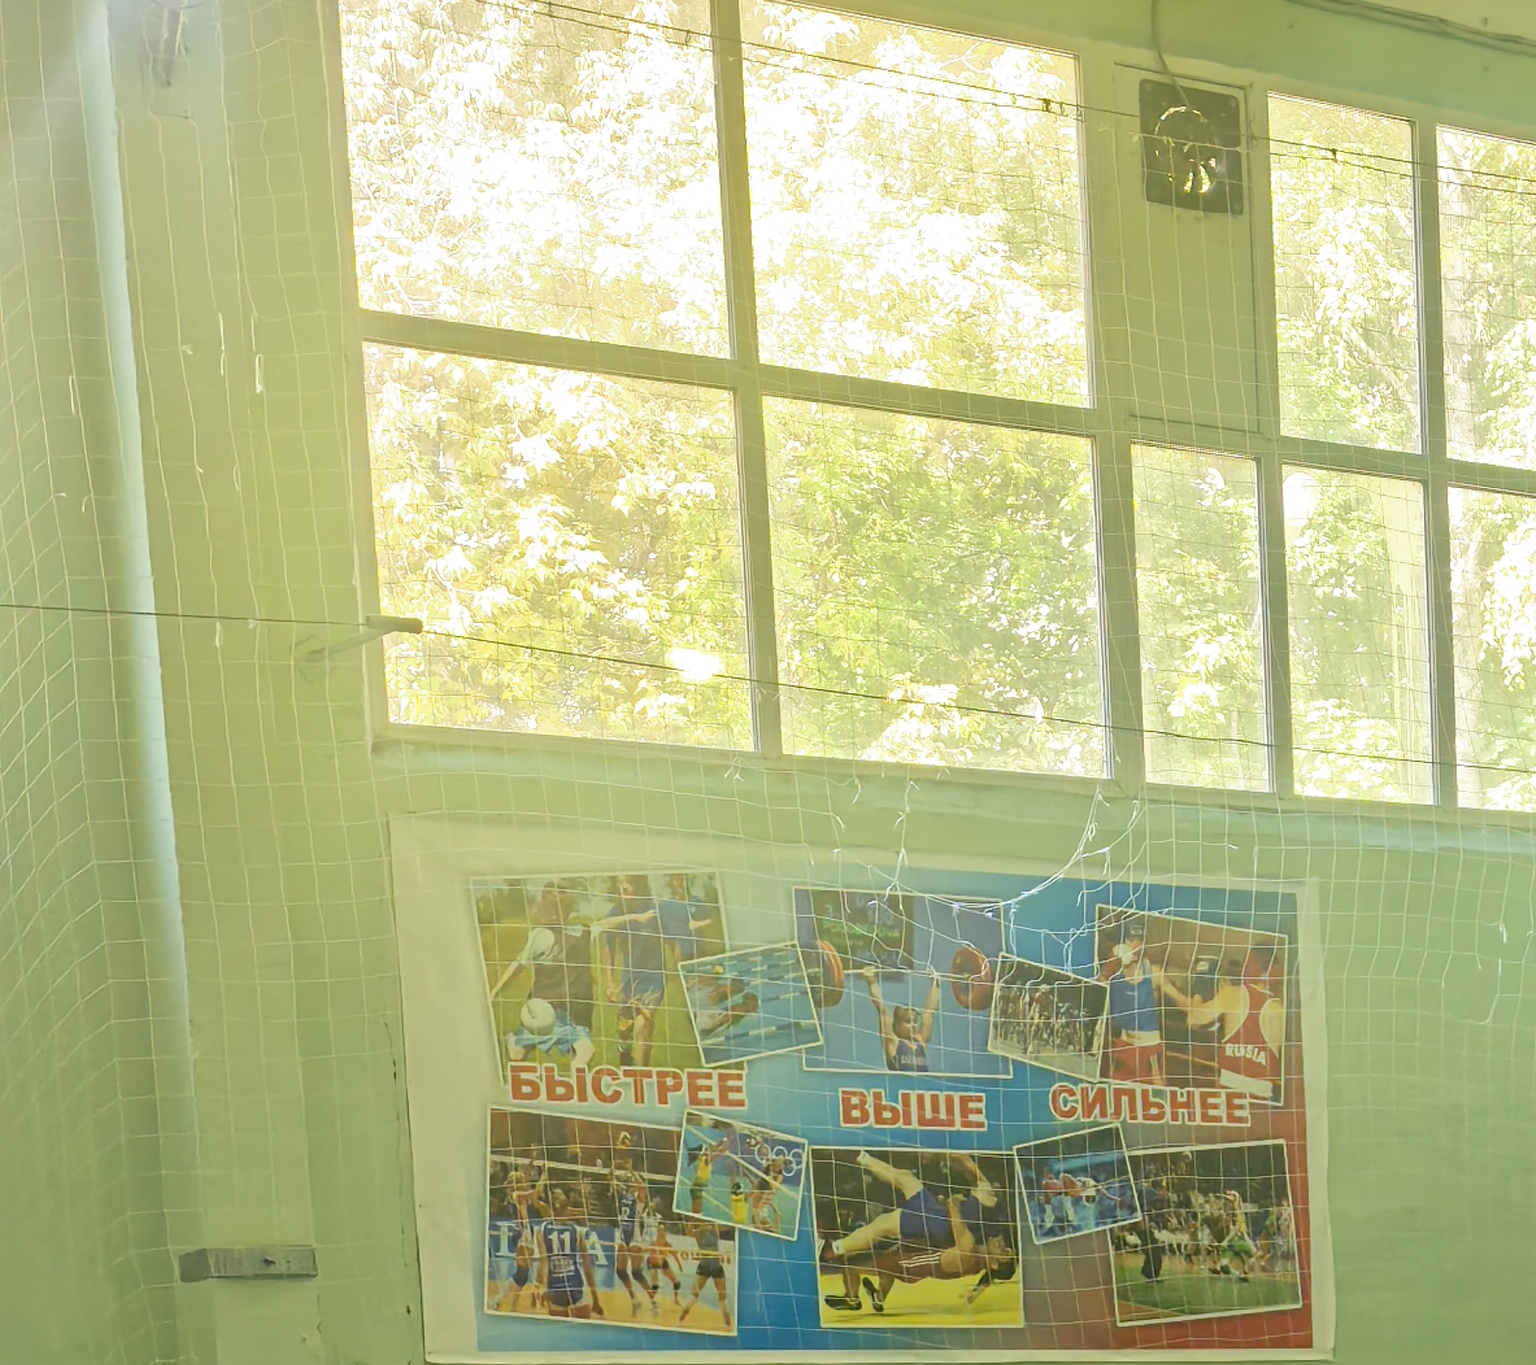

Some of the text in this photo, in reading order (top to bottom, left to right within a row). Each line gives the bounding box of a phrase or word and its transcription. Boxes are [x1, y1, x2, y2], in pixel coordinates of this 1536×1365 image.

[508, 1063, 1250, 1130] БЫСТРЕЕ ВЫШЕ СИЛЬНЕЕ
[548, 1231, 571, 1254] 11
